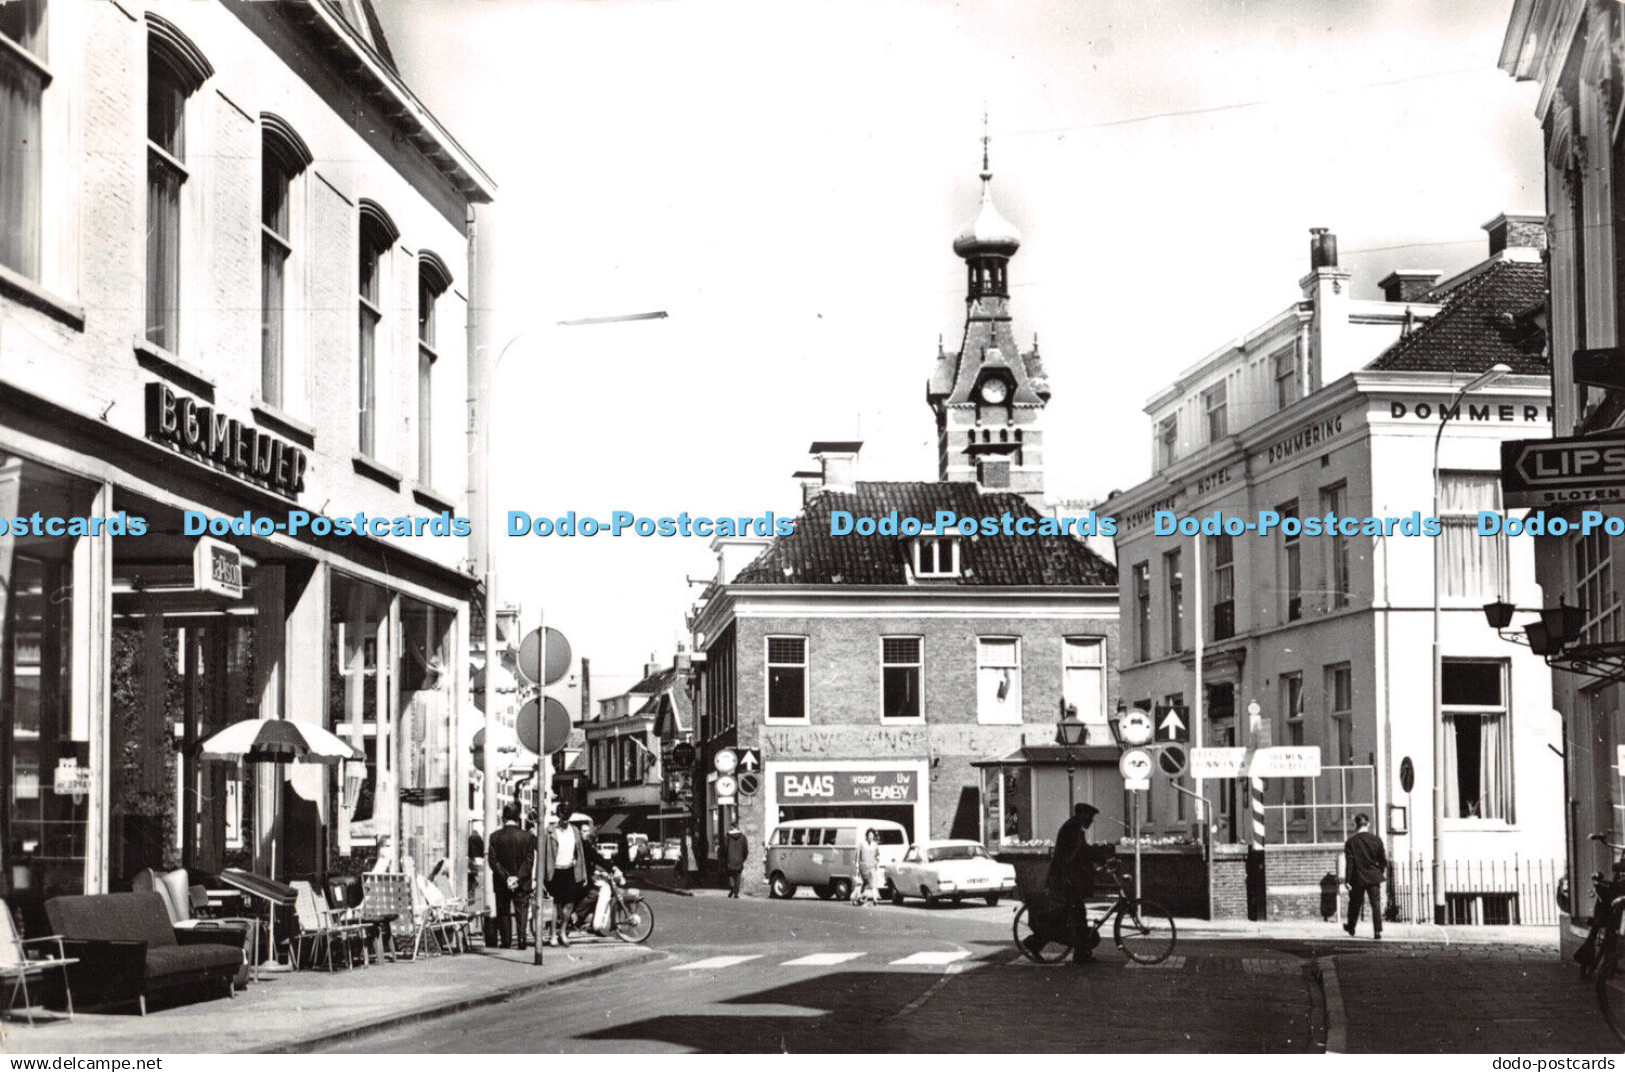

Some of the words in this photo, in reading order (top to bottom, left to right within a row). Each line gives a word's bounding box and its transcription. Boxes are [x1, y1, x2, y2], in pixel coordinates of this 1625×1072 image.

[1269, 415, 1342, 463] DOMMERING
[1536, 449, 1625, 476] LIPS
[1198, 468, 1231, 494] HOTEL
[1544, 489, 1620, 501] SLOTEN
[783, 775, 834, 797] BAAS
[871, 785, 909, 799] BABY
